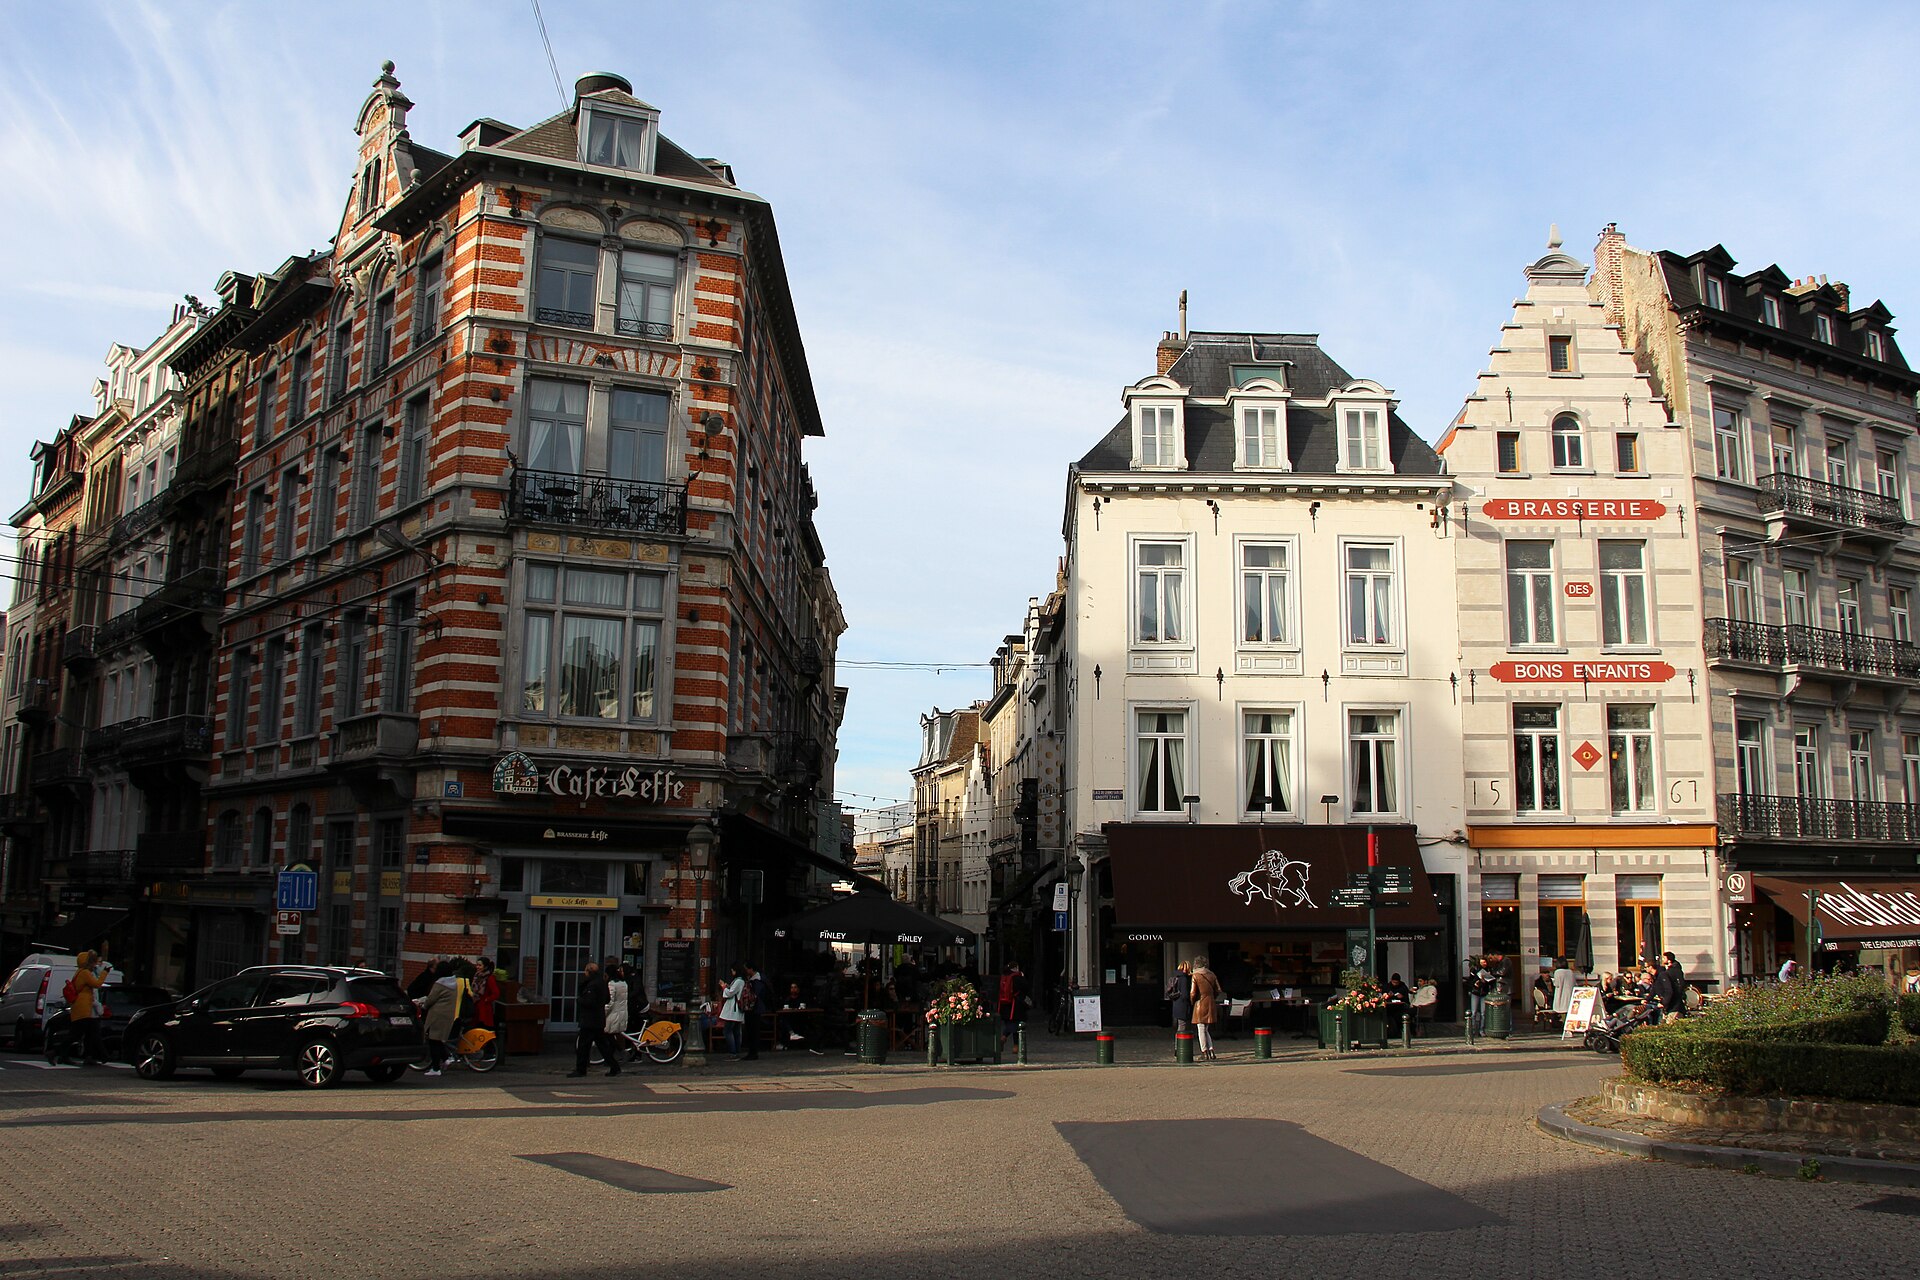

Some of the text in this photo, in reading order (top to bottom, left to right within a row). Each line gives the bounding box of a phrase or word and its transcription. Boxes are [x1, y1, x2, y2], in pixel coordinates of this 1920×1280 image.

[1508, 502, 1641, 516] BRASSERIE
[1569, 584, 1589, 594] DES
[1514, 664, 1651, 678] BONS ENFANTS
[545, 764, 684, 804] Café Leffe
[590, 830, 608, 841] Leffe
[1730, 877, 1742, 889] N
[1825, 942, 1838, 951] 1857
[1861, 941, 1873, 949] THE
[1873, 940, 1896, 949] LEADING
[1895, 939, 1917, 948] LUXURY
